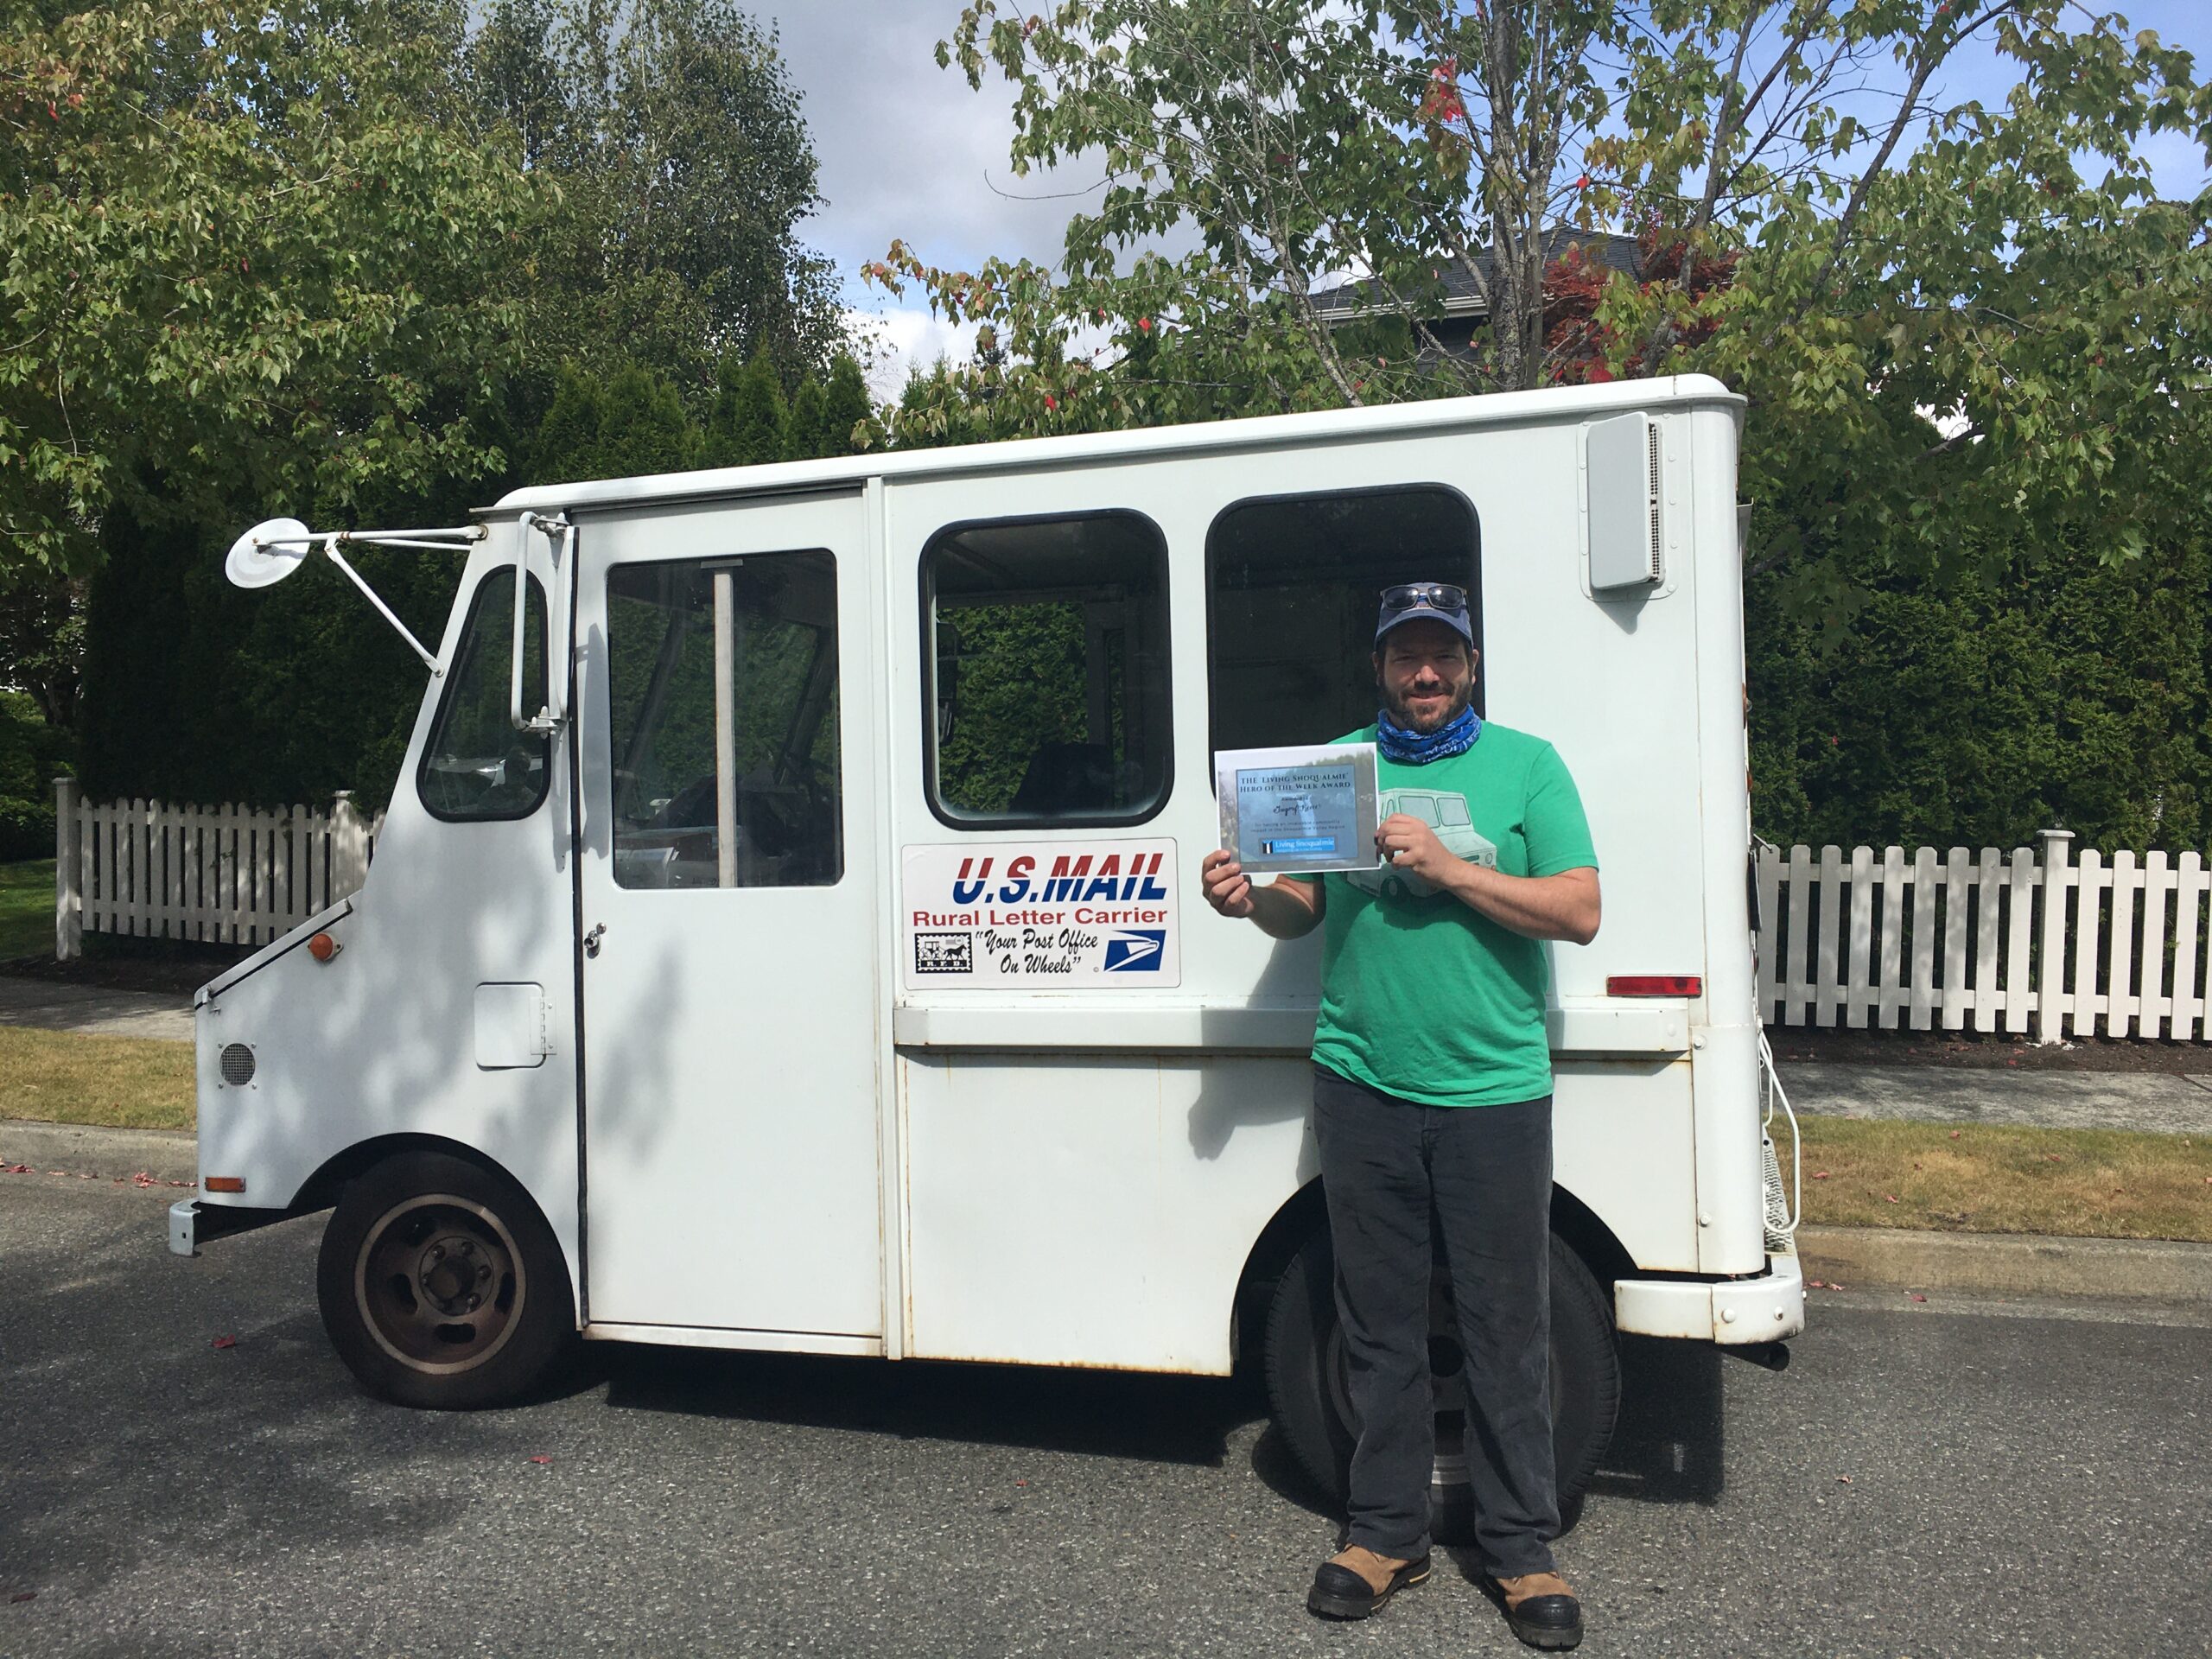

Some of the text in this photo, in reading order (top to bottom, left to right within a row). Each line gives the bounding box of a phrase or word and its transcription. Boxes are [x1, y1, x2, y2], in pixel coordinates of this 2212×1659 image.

[912, 907, 1167, 926] Rural Letter Carrier
[1022, 928, 1054, 950] Post
[1058, 928, 1098, 954] Office
[1000, 955, 1020, 974] On
